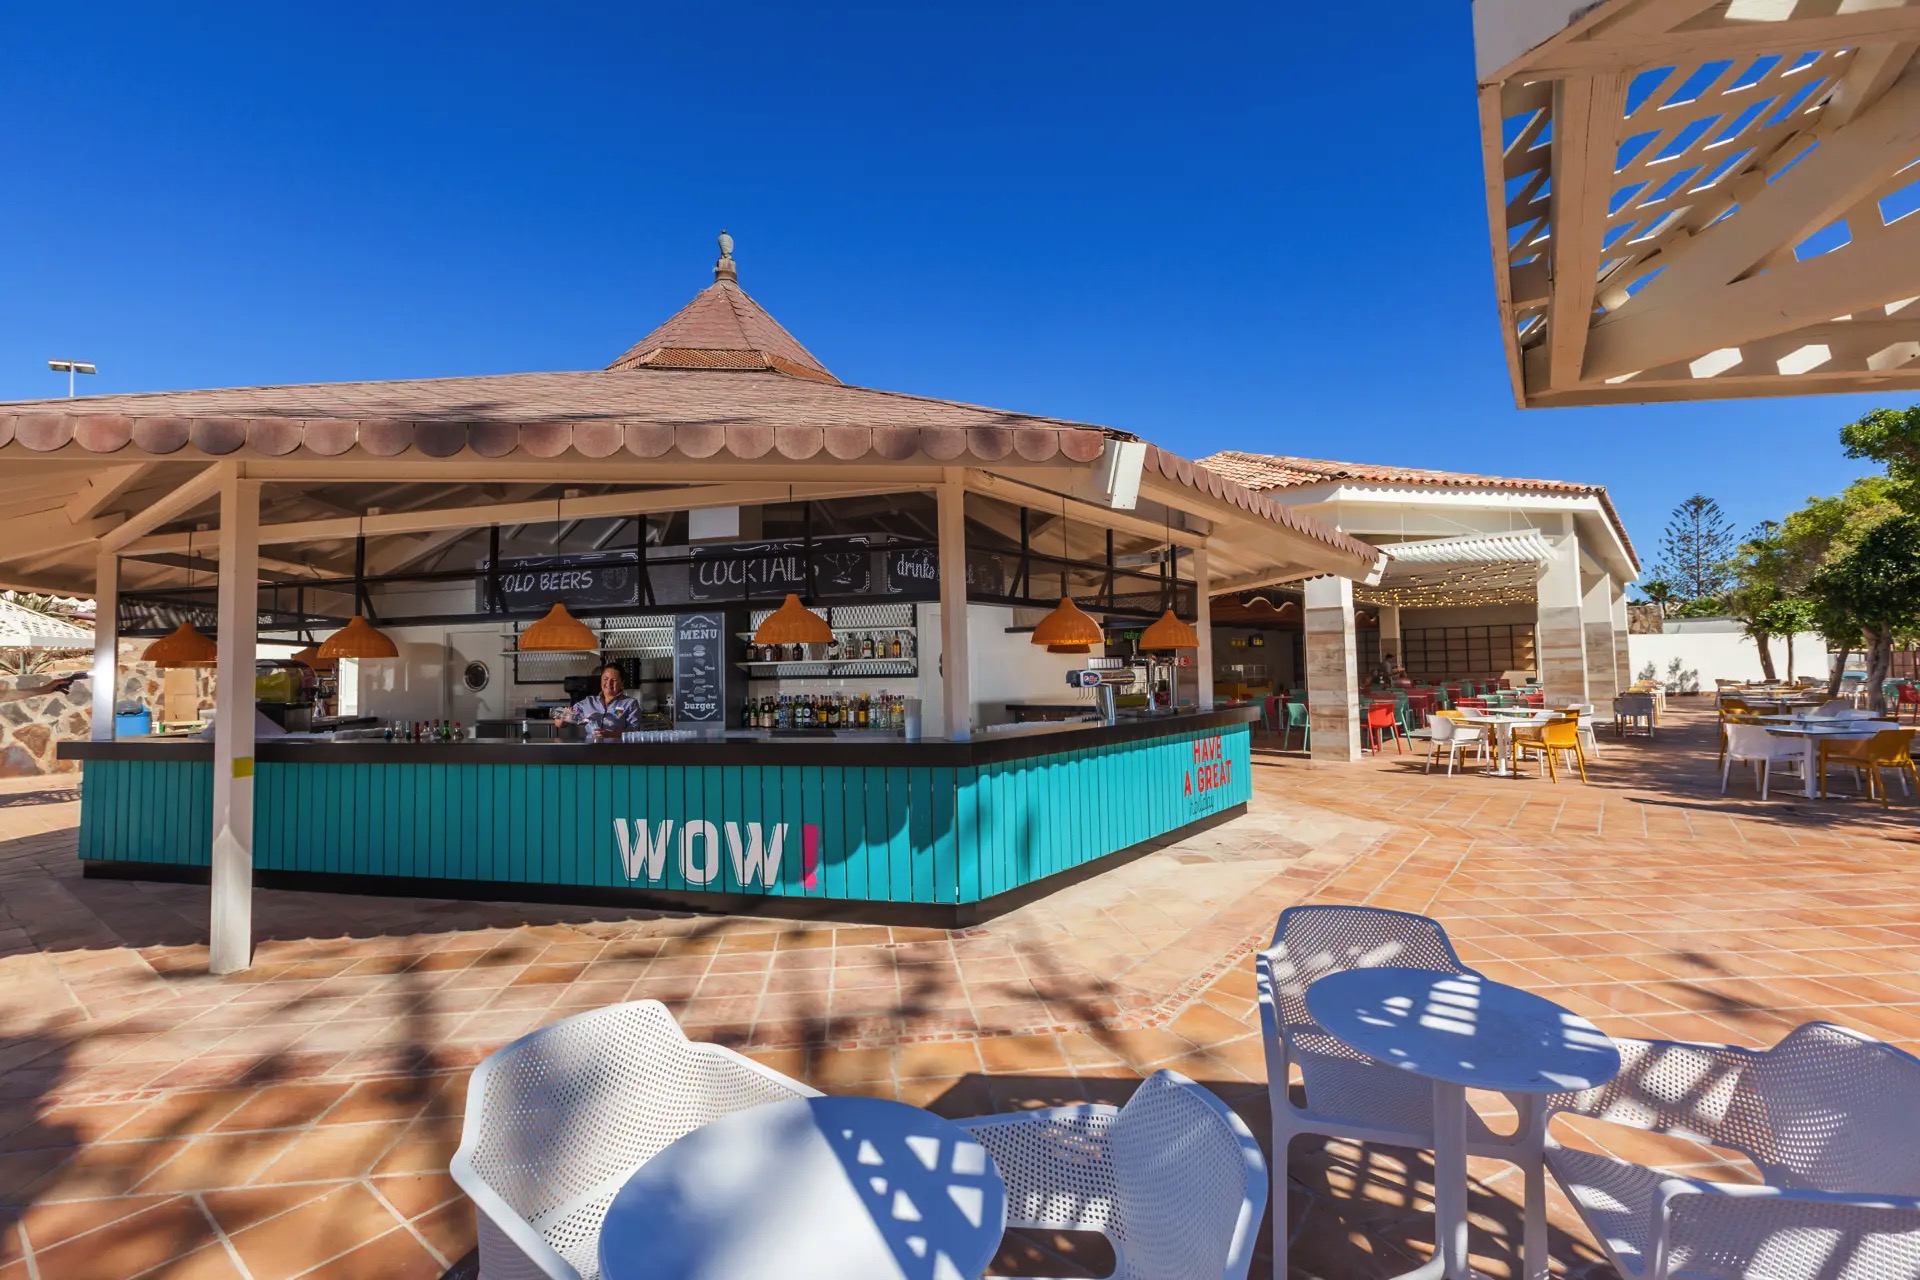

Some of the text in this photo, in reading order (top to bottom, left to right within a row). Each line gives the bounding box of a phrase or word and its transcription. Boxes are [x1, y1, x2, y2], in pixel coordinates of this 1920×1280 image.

[498, 570, 594, 593] OLD BEERS
[680, 629, 718, 640] MENU
[684, 701, 716, 712] burger
[1193, 735, 1223, 765] HAVE
[1184, 760, 1232, 798] A GREAT
